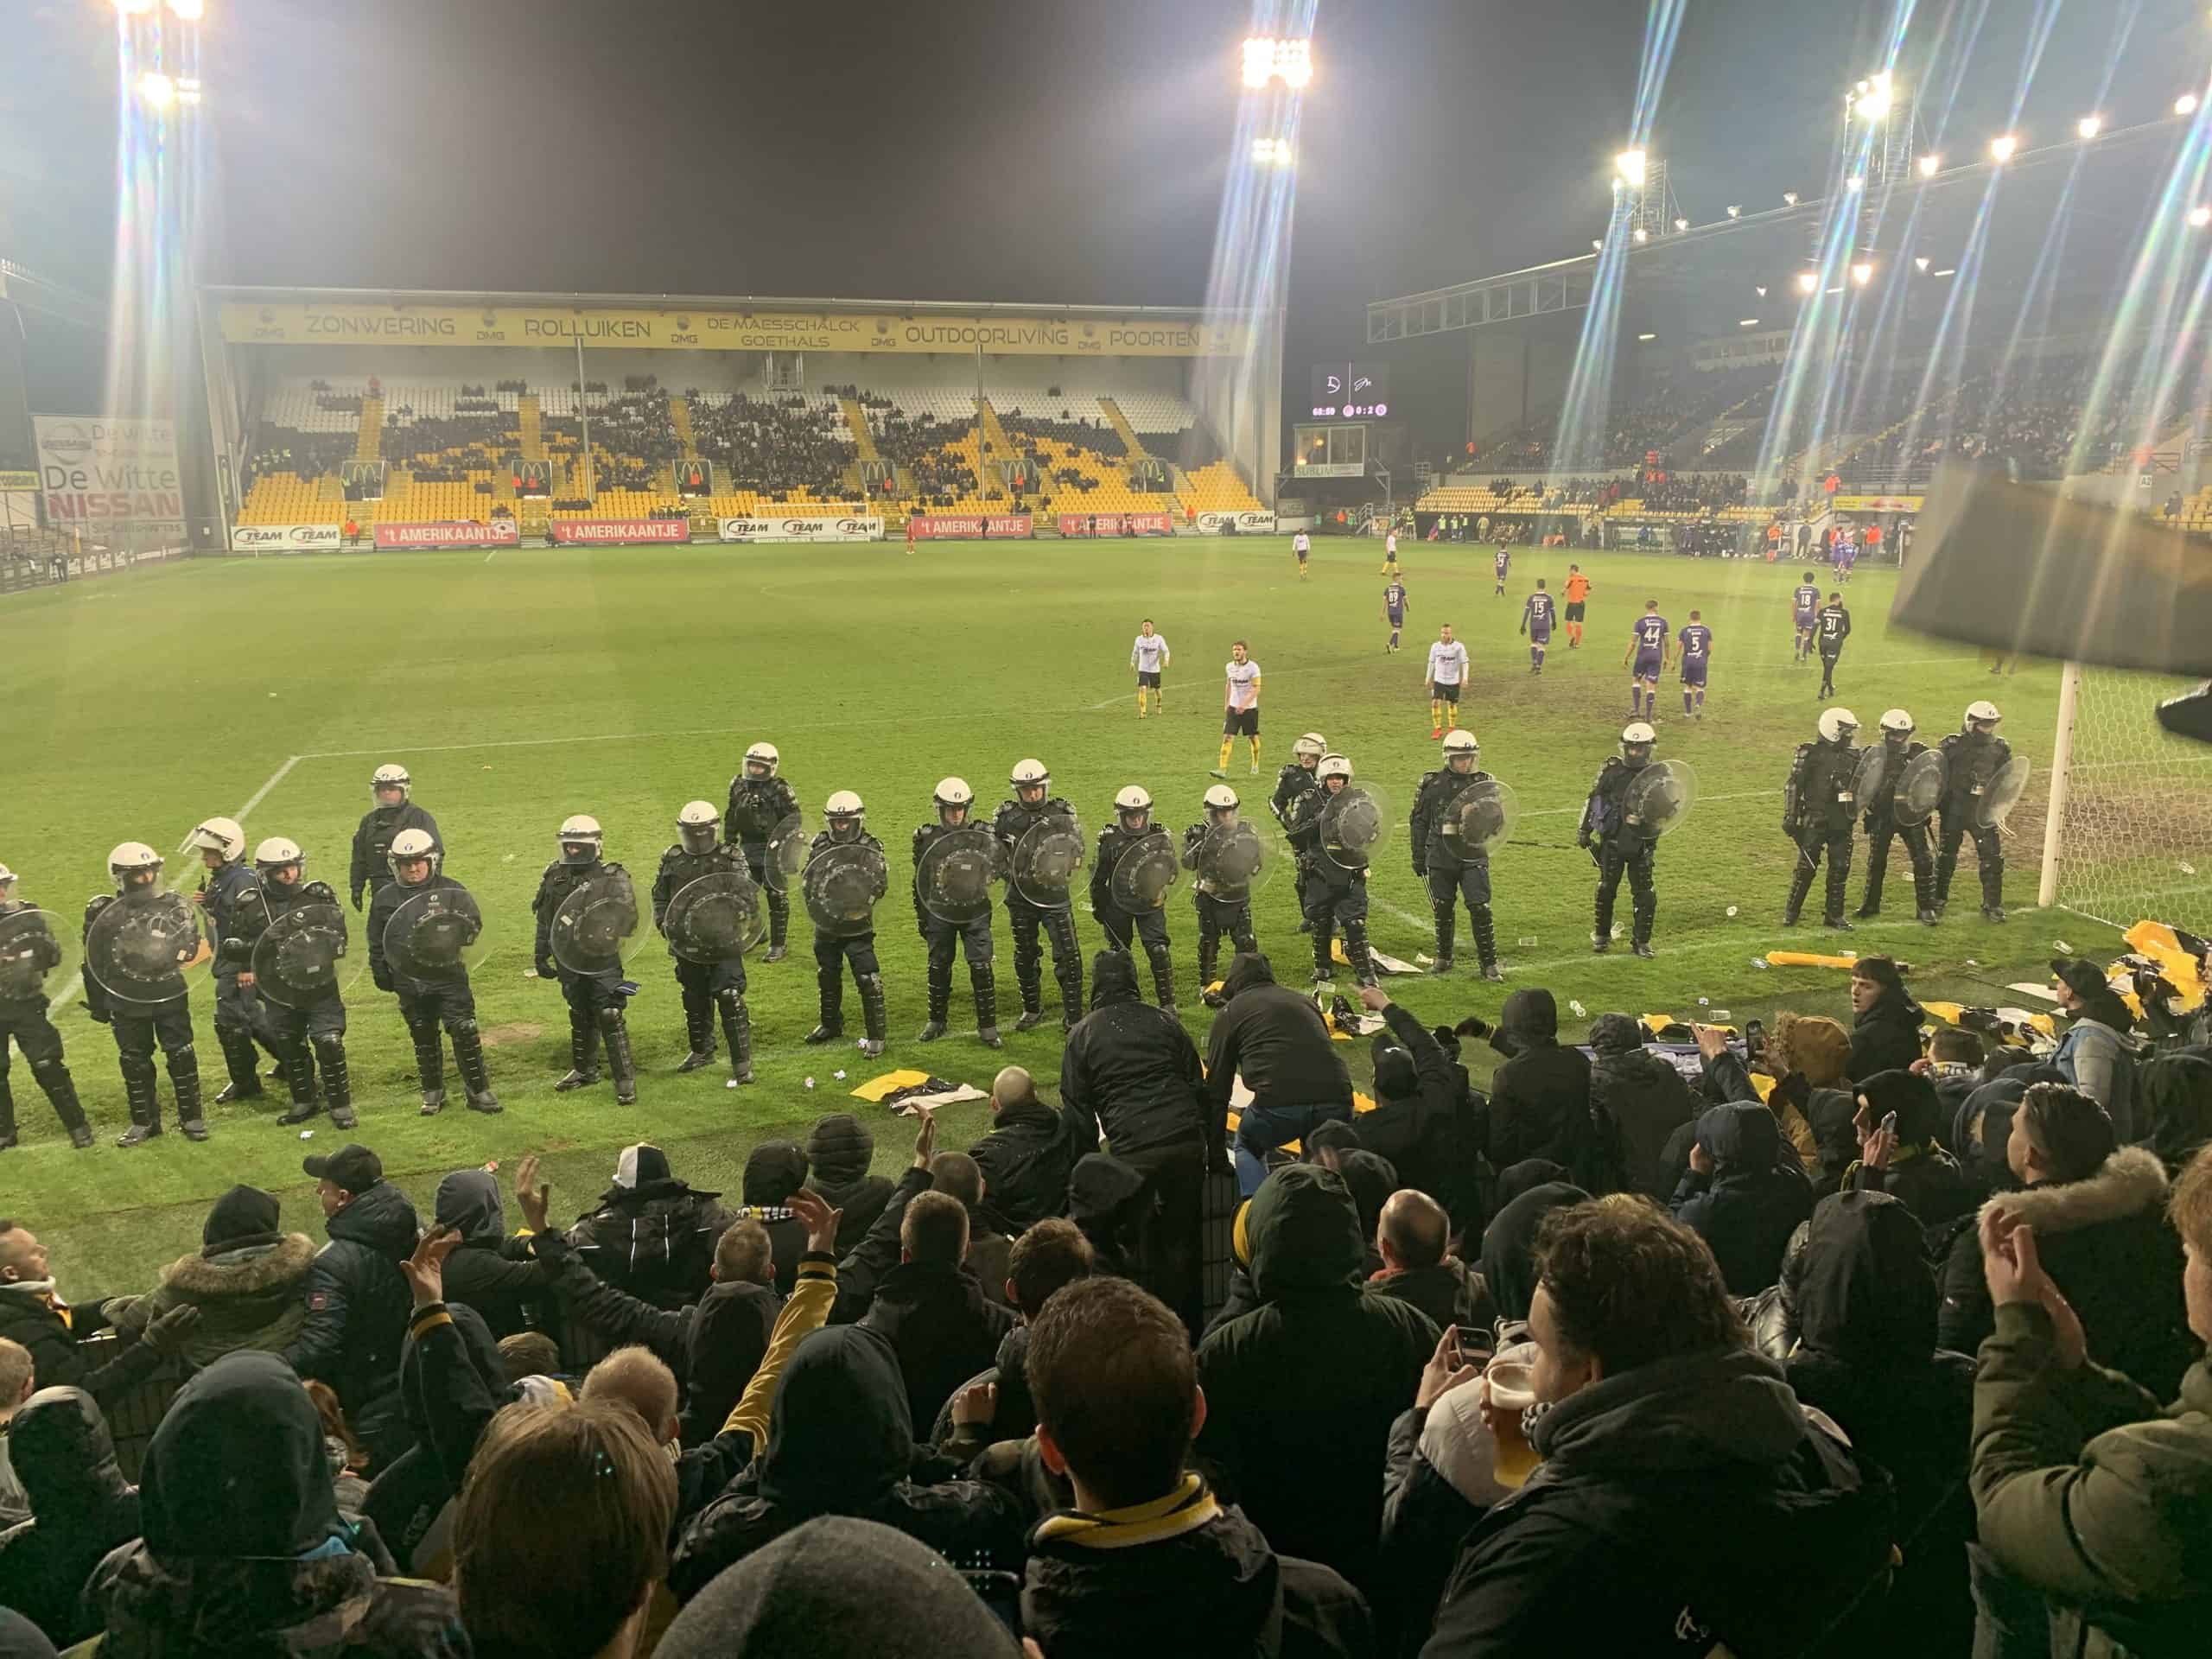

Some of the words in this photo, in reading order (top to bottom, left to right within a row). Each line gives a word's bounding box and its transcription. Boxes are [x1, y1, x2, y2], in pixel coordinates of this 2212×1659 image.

[306, 315, 455, 335] ZONWERING
[524, 319, 651, 338] ROLLUIKEN
[707, 317, 729, 330] DE
[734, 317, 860, 333] MAESSCHALCK
[476, 331, 505, 340] DMG
[671, 334, 698, 344] DMG
[741, 334, 830, 347] GOETHALS
[871, 338, 897, 346] DMG
[906, 326, 1069, 345] OUTDOORLIVING
[1109, 330, 1200, 346] POORTEN
[45, 465, 88, 490] De
[95, 464, 177, 490] Witte
[48, 493, 181, 518] NISSAN
[575, 524, 679, 538] AMERIKAANTJE
[737, 523, 769, 532] TEAM
[792, 523, 823, 532] TEAM
[932, 519, 1024, 533] AMERIKANTJE
[245, 531, 283, 540] TEAM
[302, 531, 337, 540] TEAM
[1389, 591, 1399, 603] 89
[1801, 594, 1811, 606] 18
[1534, 601, 1544, 613] 15
[1825, 617, 1838, 632] 31
[1643, 626, 1661, 642] 44
[1692, 636, 1700, 651] 5
